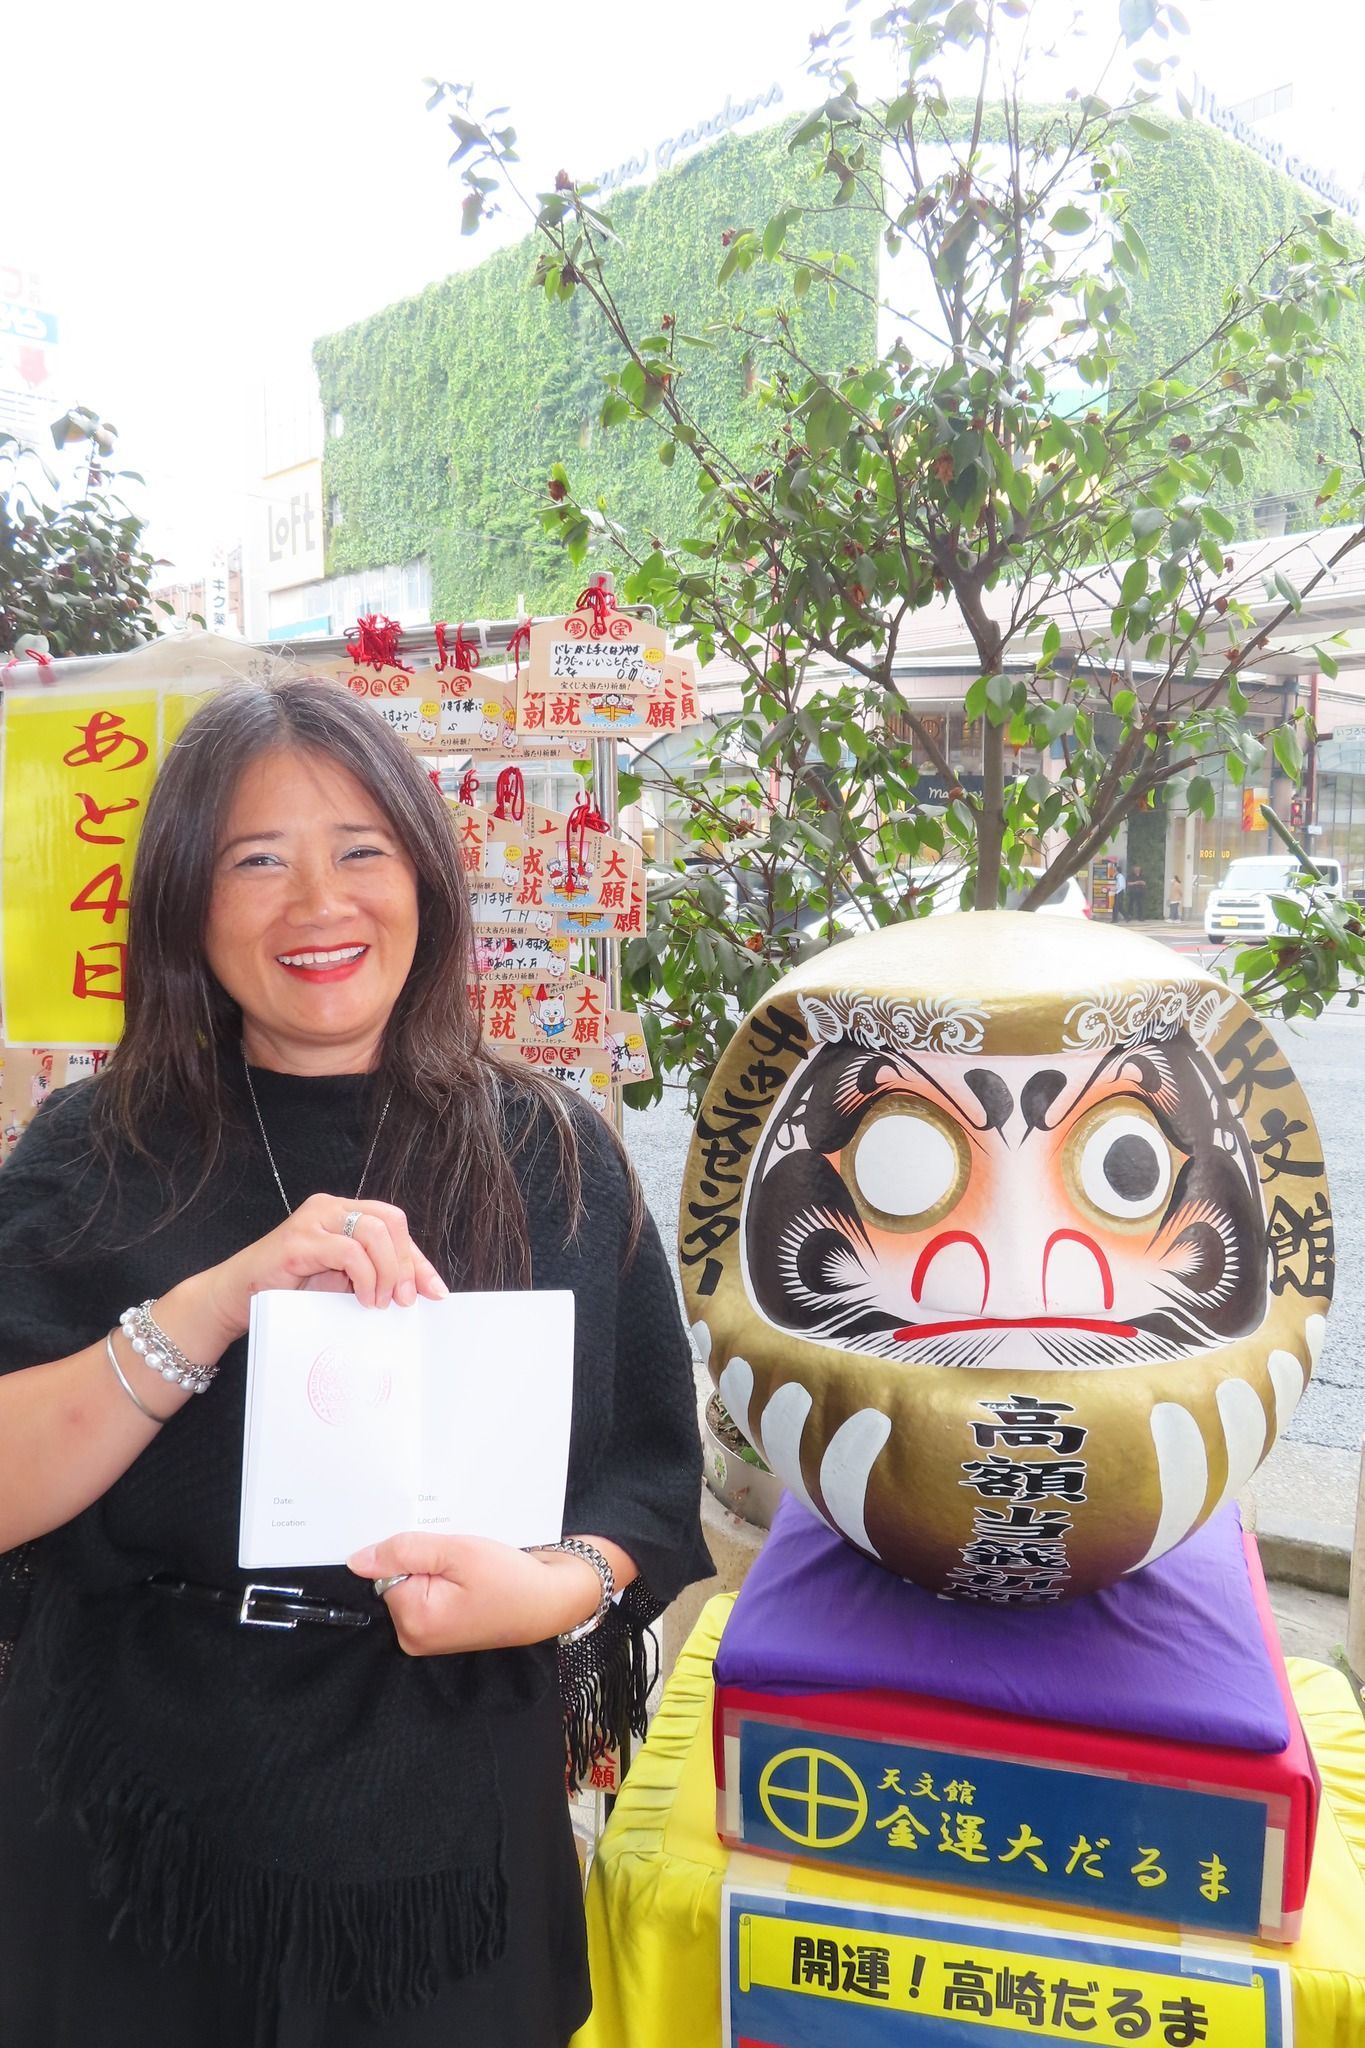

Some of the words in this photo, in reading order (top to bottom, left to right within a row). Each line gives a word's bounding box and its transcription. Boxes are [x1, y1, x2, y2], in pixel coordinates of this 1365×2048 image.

[598, 850, 629, 910] 大願
[489, 984, 518, 1040] 成就
[571, 986, 603, 1045] 大願
[680, 1004, 809, 1296] チャンスセンター
[1216, 1018, 1336, 1299] 天文館
[271, 1518, 307, 1528] Location:
[876, 1767, 977, 1807] 天文館
[875, 1803, 1231, 1904] 金運大だるま
[790, 1936, 1209, 2048] 開運！高崎だるま
